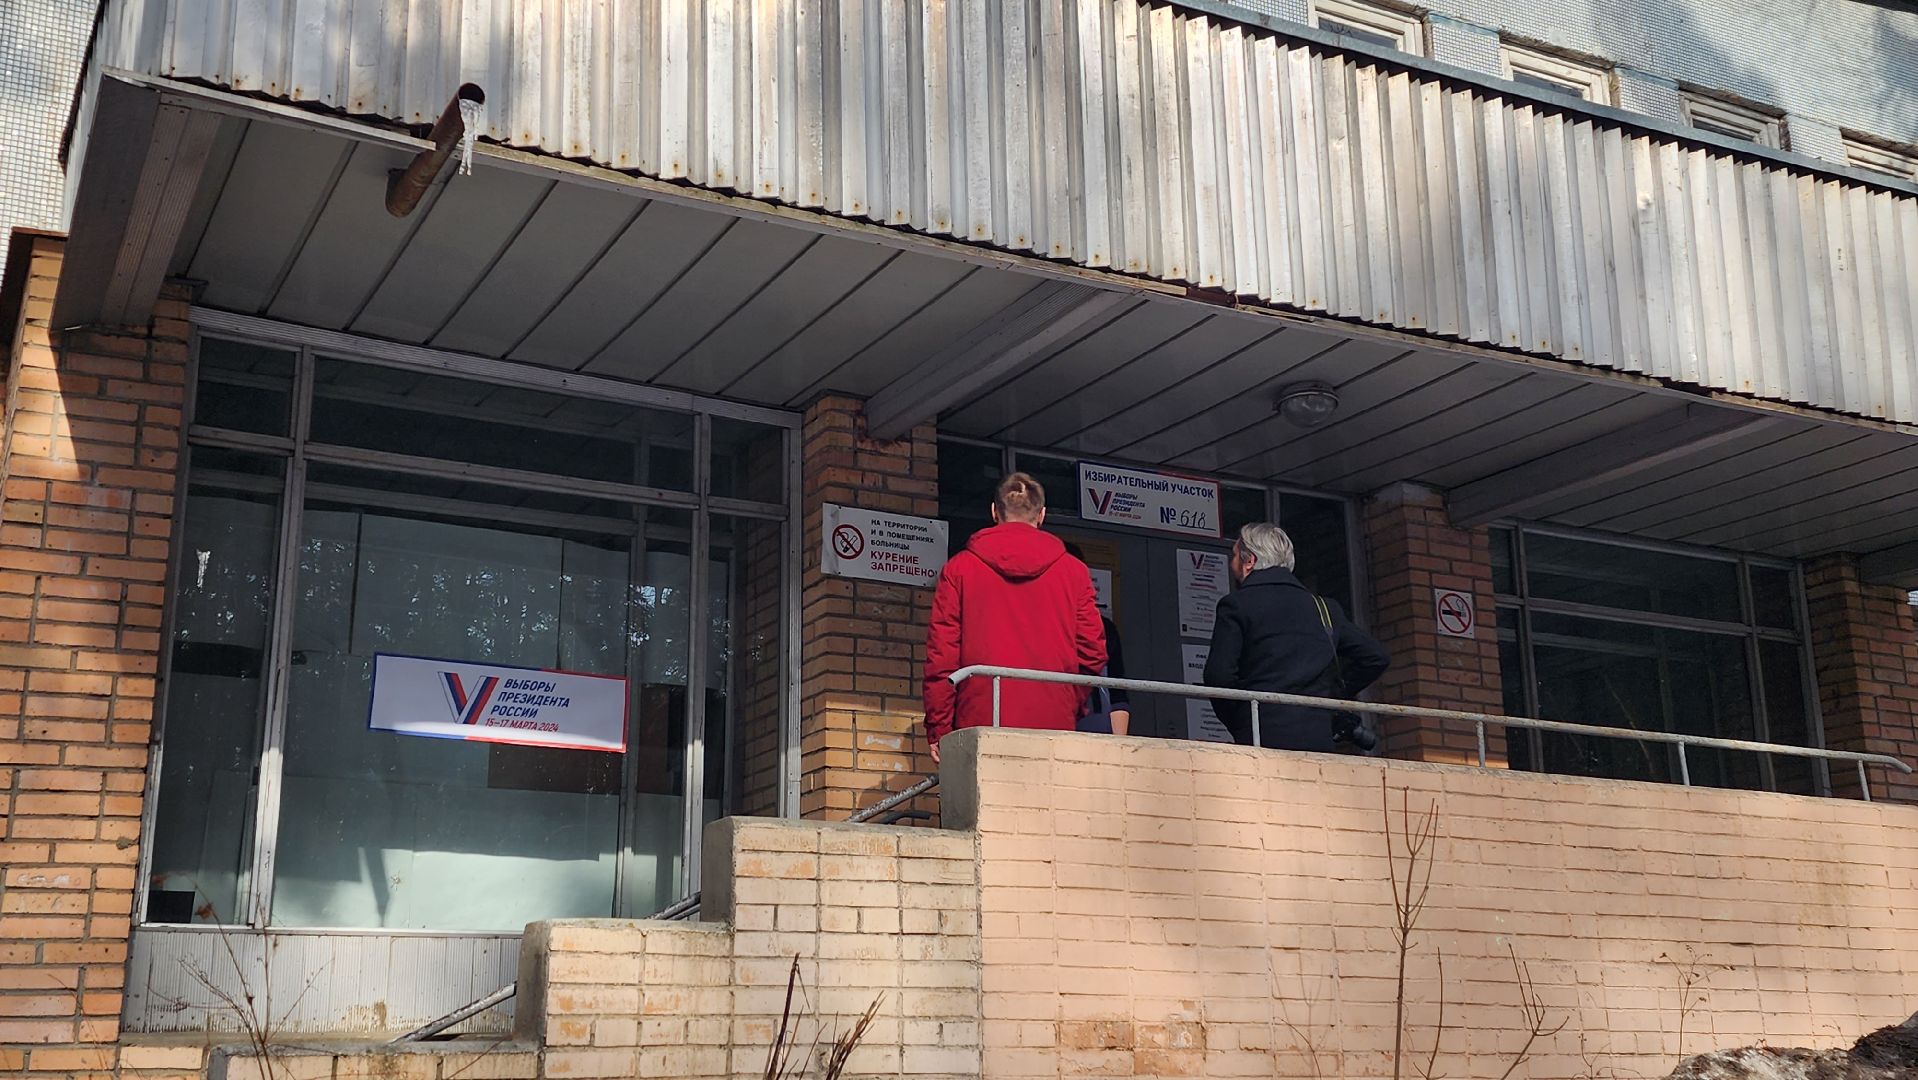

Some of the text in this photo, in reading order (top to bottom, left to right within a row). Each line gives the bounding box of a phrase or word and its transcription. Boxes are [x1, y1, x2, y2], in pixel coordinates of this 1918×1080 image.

[1084, 469, 1215, 499] ИЗБИРАТЕЛЬНЫЙ УЧАСТОК
[884, 520, 928, 533] ТЕРРИТОРИИ
[1180, 509, 1206, 529] 618
[870, 528, 934, 544] И В ПОМЕЩЕНИЯХ
[870, 539, 910, 551] БОЛЬНИЦЫ
[870, 550, 919, 565] КУРЕНИЕ
[504, 678, 556, 693] ВЫБОРЫ
[498, 692, 571, 708] ПРЕЗИДЕНТА
[490, 706, 539, 719] РОССИИ
[509, 720, 538, 731] МАРТА
[537, 722, 560, 733] 2024
